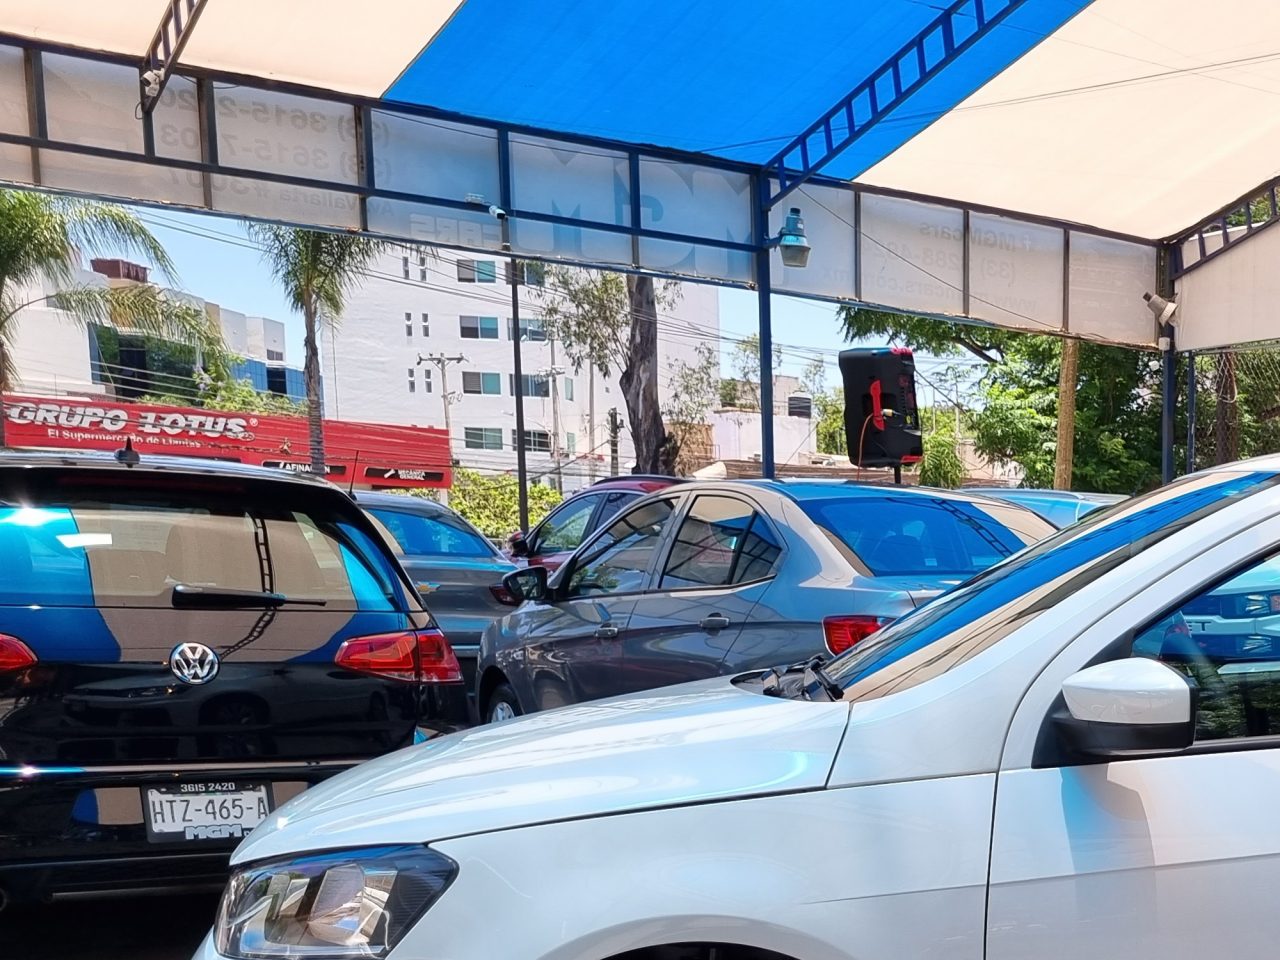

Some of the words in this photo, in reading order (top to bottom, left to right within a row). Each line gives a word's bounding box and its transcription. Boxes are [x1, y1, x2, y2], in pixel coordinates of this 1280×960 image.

[8, 402, 129, 432] GRUPO
[137, 411, 249, 439] LOTUS
[47, 429, 60, 439] El
[285, 463, 331, 474] AFINAN
[180, 783, 206, 793] 3615
[207, 782, 236, 792] 2420
[151, 797, 268, 824] HTZ-465-A
[184, 823, 243, 840] MGM
